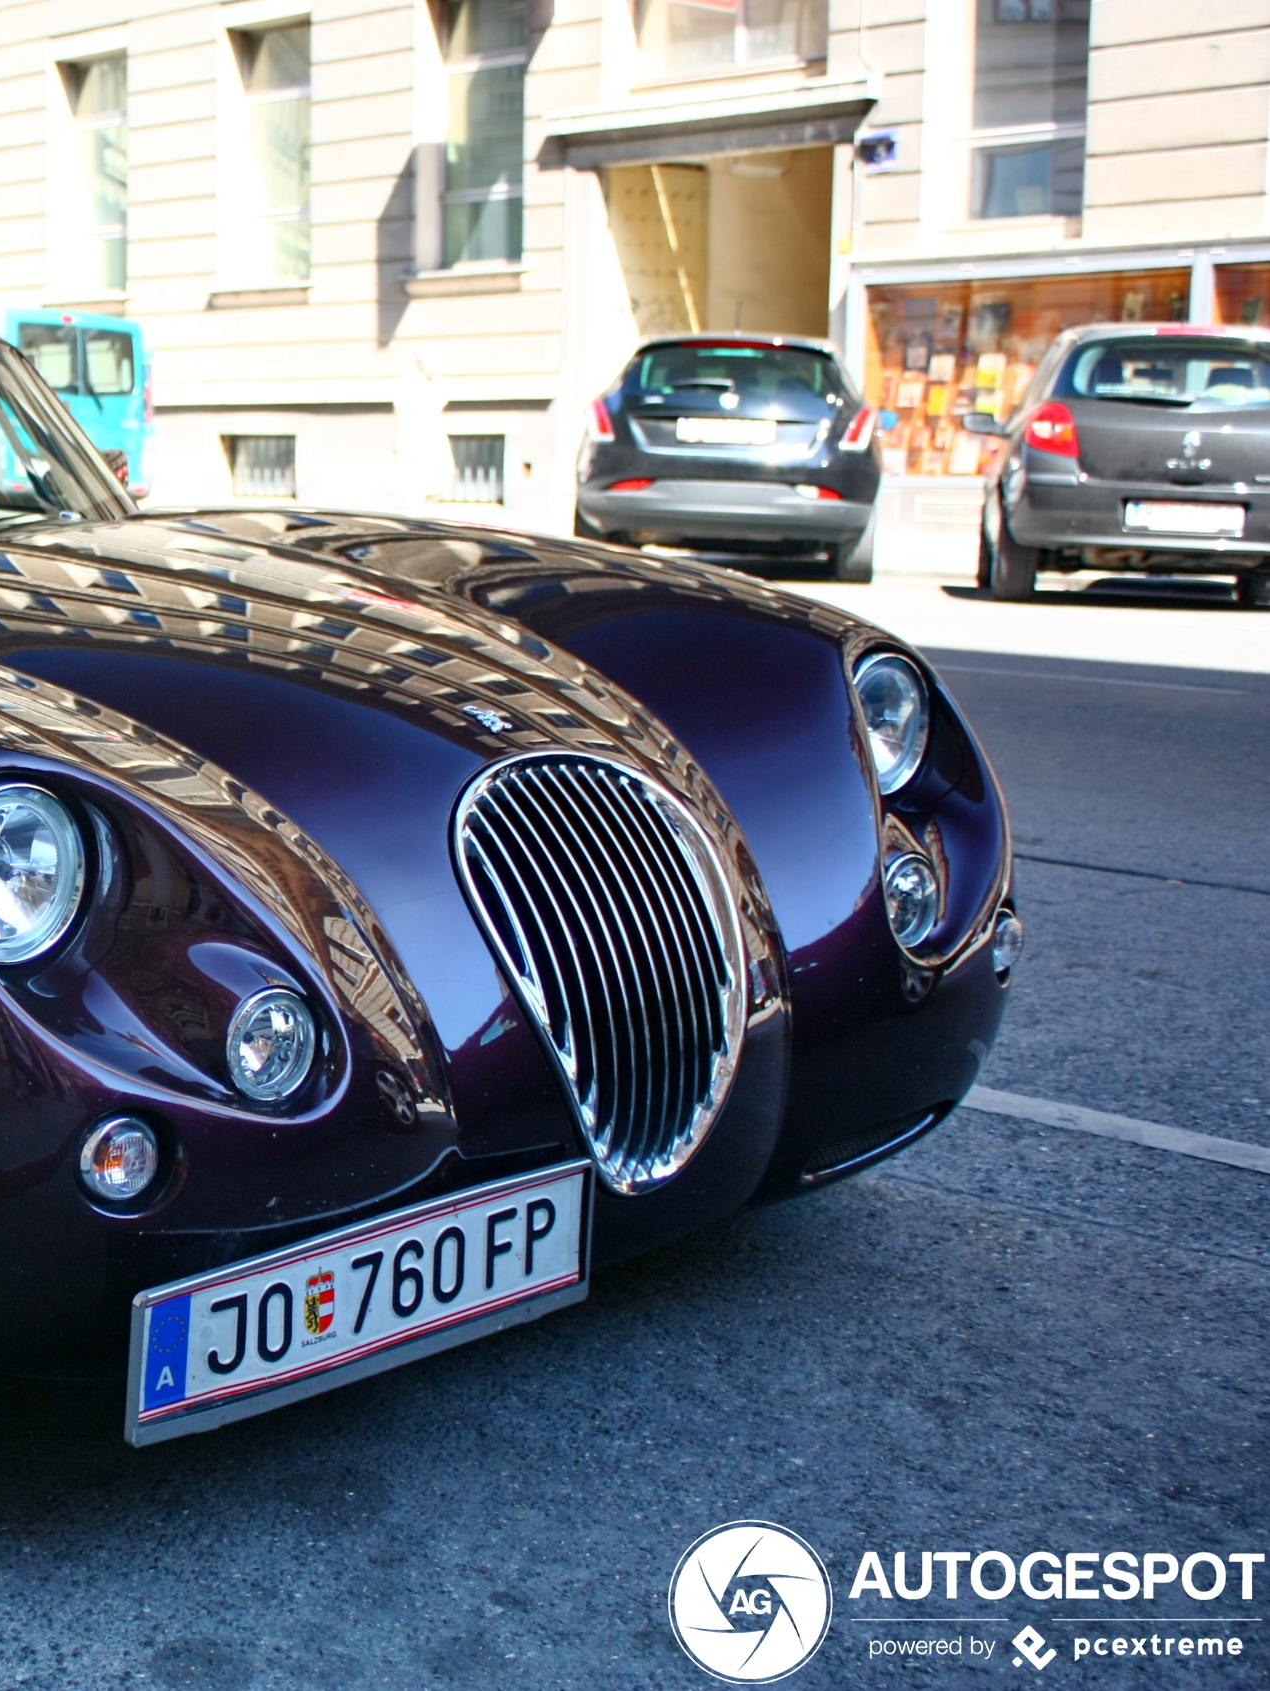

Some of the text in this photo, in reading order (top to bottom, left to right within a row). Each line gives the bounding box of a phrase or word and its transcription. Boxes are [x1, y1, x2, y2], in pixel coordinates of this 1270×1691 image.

[207, 1198, 556, 1374] JO 760 FP
[301, 1331, 337, 1348] SALZBURG
[155, 1365, 176, 1391] A
